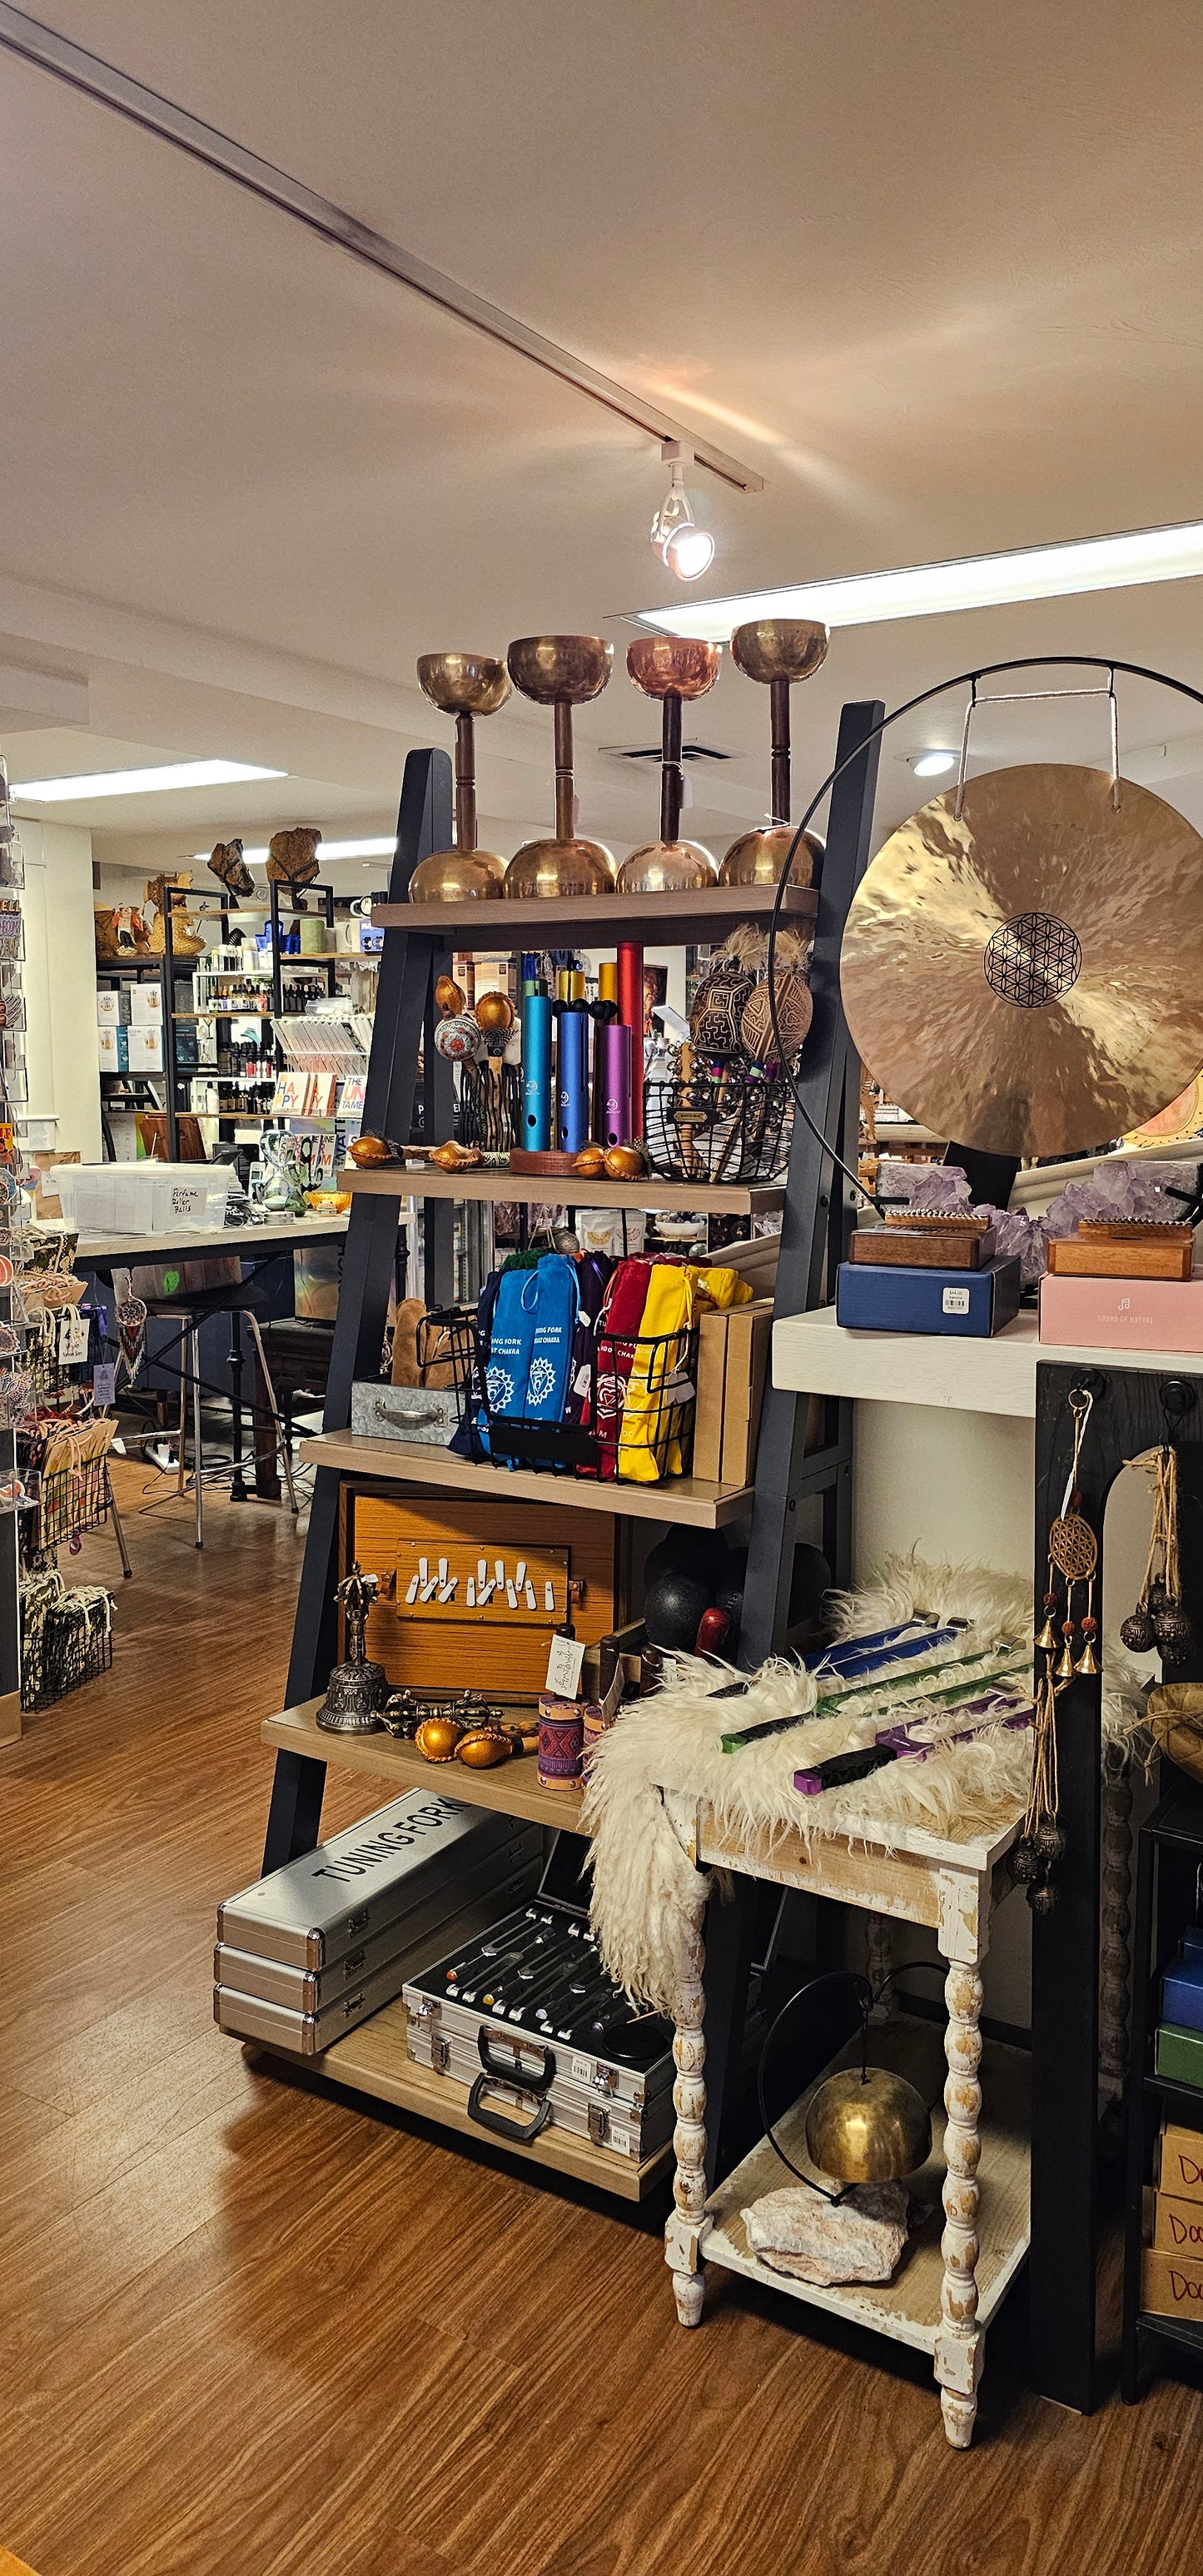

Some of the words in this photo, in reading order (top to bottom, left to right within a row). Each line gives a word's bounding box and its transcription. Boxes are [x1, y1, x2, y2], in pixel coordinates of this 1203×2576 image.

[348, 1077, 364, 1086] THE
[344, 1086, 365, 1101] UN
[1097, 1315, 1119, 1323] SOUND
[1130, 1316, 1153, 1325] NATURE
[311, 1832, 415, 1882] TUNING
[392, 1798, 472, 1836] FORK
